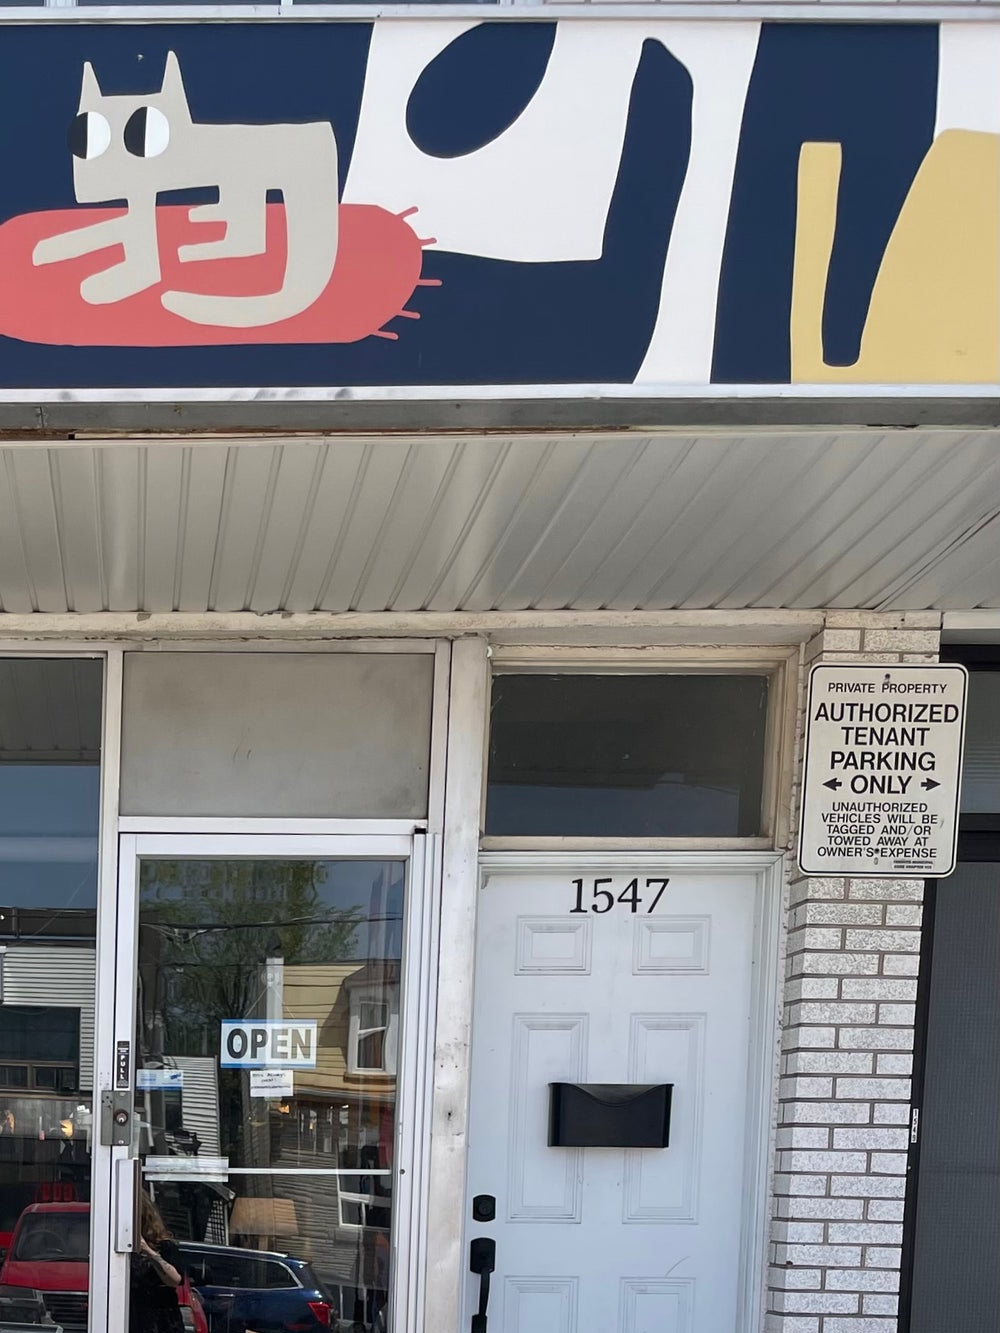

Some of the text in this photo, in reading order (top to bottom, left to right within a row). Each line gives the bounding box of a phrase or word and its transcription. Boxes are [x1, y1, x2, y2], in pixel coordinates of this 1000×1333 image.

[828, 682, 947, 694] PRIVATE PROPERTY
[815, 702, 959, 723] AUTHORIZED
[841, 726, 930, 746] TENANT
[830, 751, 936, 771] PARKING
[850, 774, 912, 795] ONLY
[832, 802, 928, 813] UNAUTHORIZED
[821, 813, 938, 824] VEHICLES WILL BE
[827, 824, 932, 836] TAGGED AND/OR
[828, 835, 929, 847] TOWED AWAY AT
[817, 846, 937, 858] OWNER'S EXPENSE
[569, 878, 670, 913] 1547
[227, 1028, 311, 1059] OPEN
